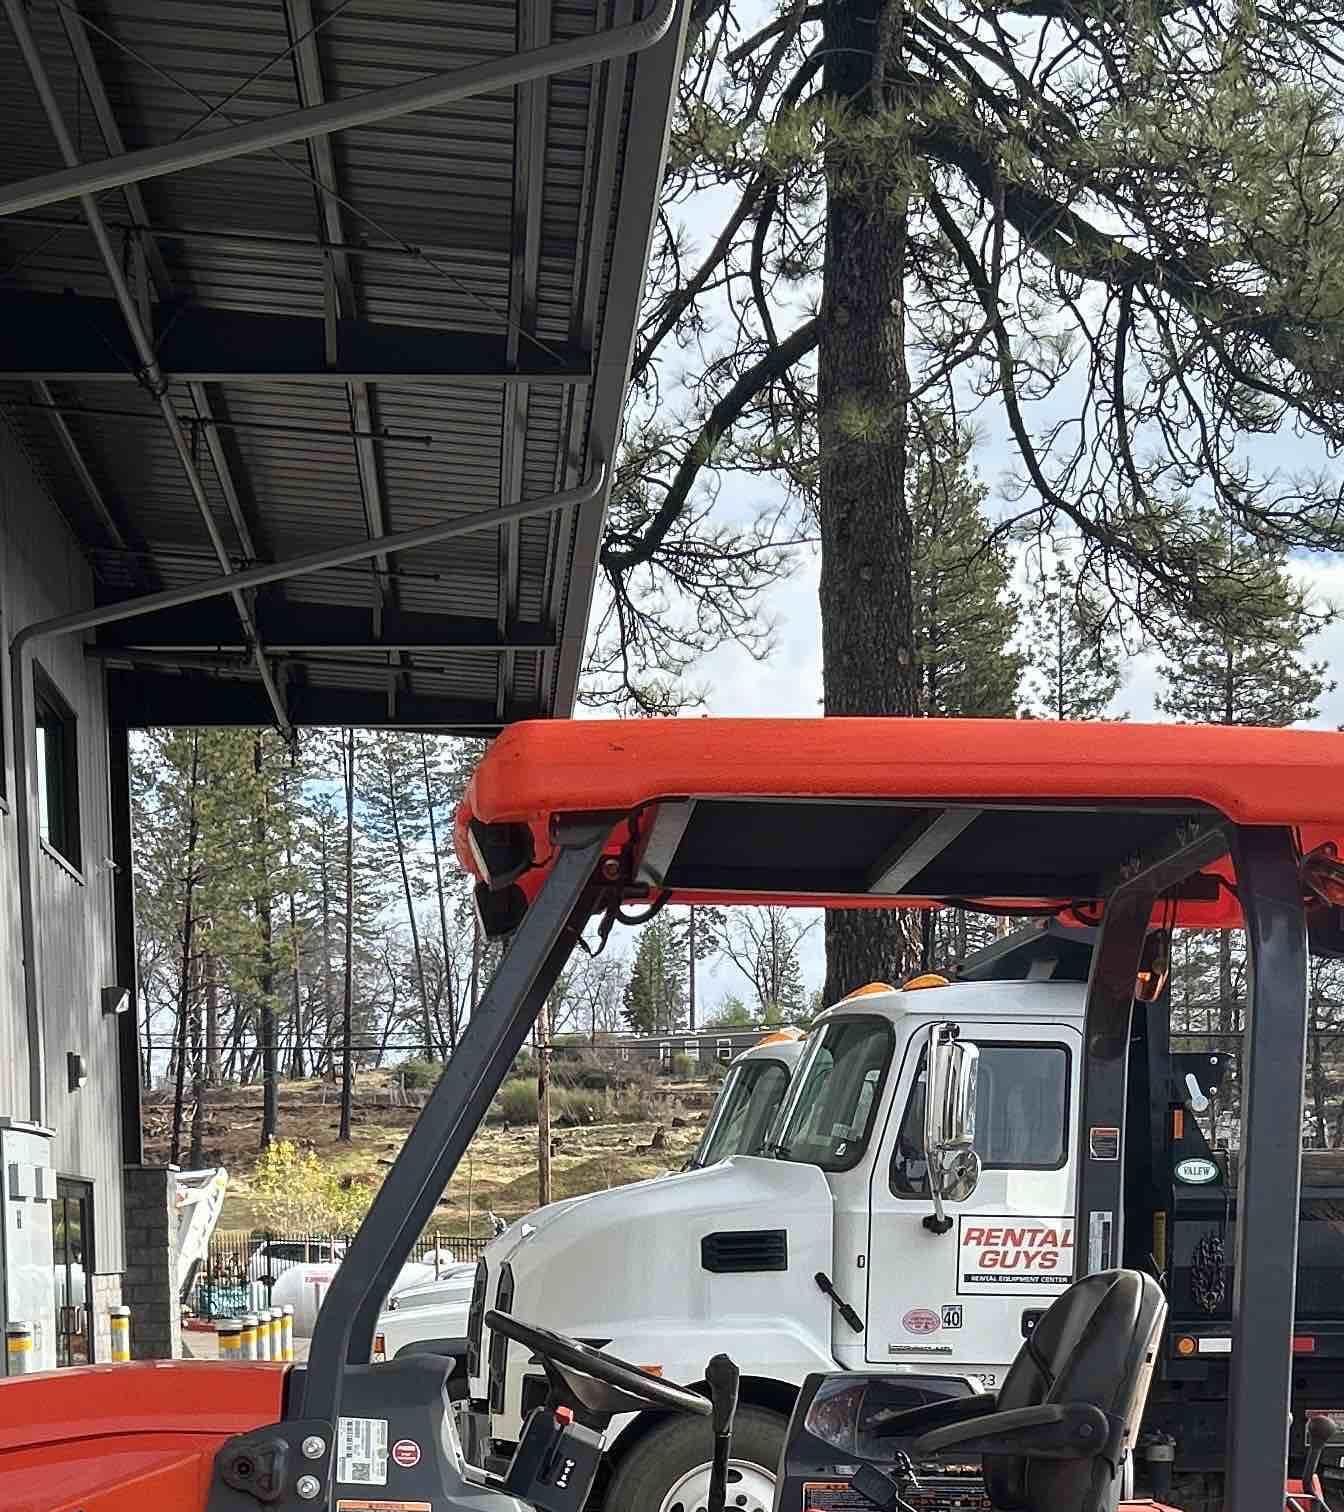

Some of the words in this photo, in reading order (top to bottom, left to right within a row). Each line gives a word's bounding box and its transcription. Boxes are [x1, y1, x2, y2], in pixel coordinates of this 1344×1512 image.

[962, 1228, 1075, 1248] RENTAL
[978, 1250, 1059, 1269] GUYS
[971, 1274, 997, 1282] RENTAL
[999, 1275, 1039, 1283] EQUIPMENT
[1040, 1275, 1068, 1283] CENTER
[943, 1312, 960, 1326] 40
